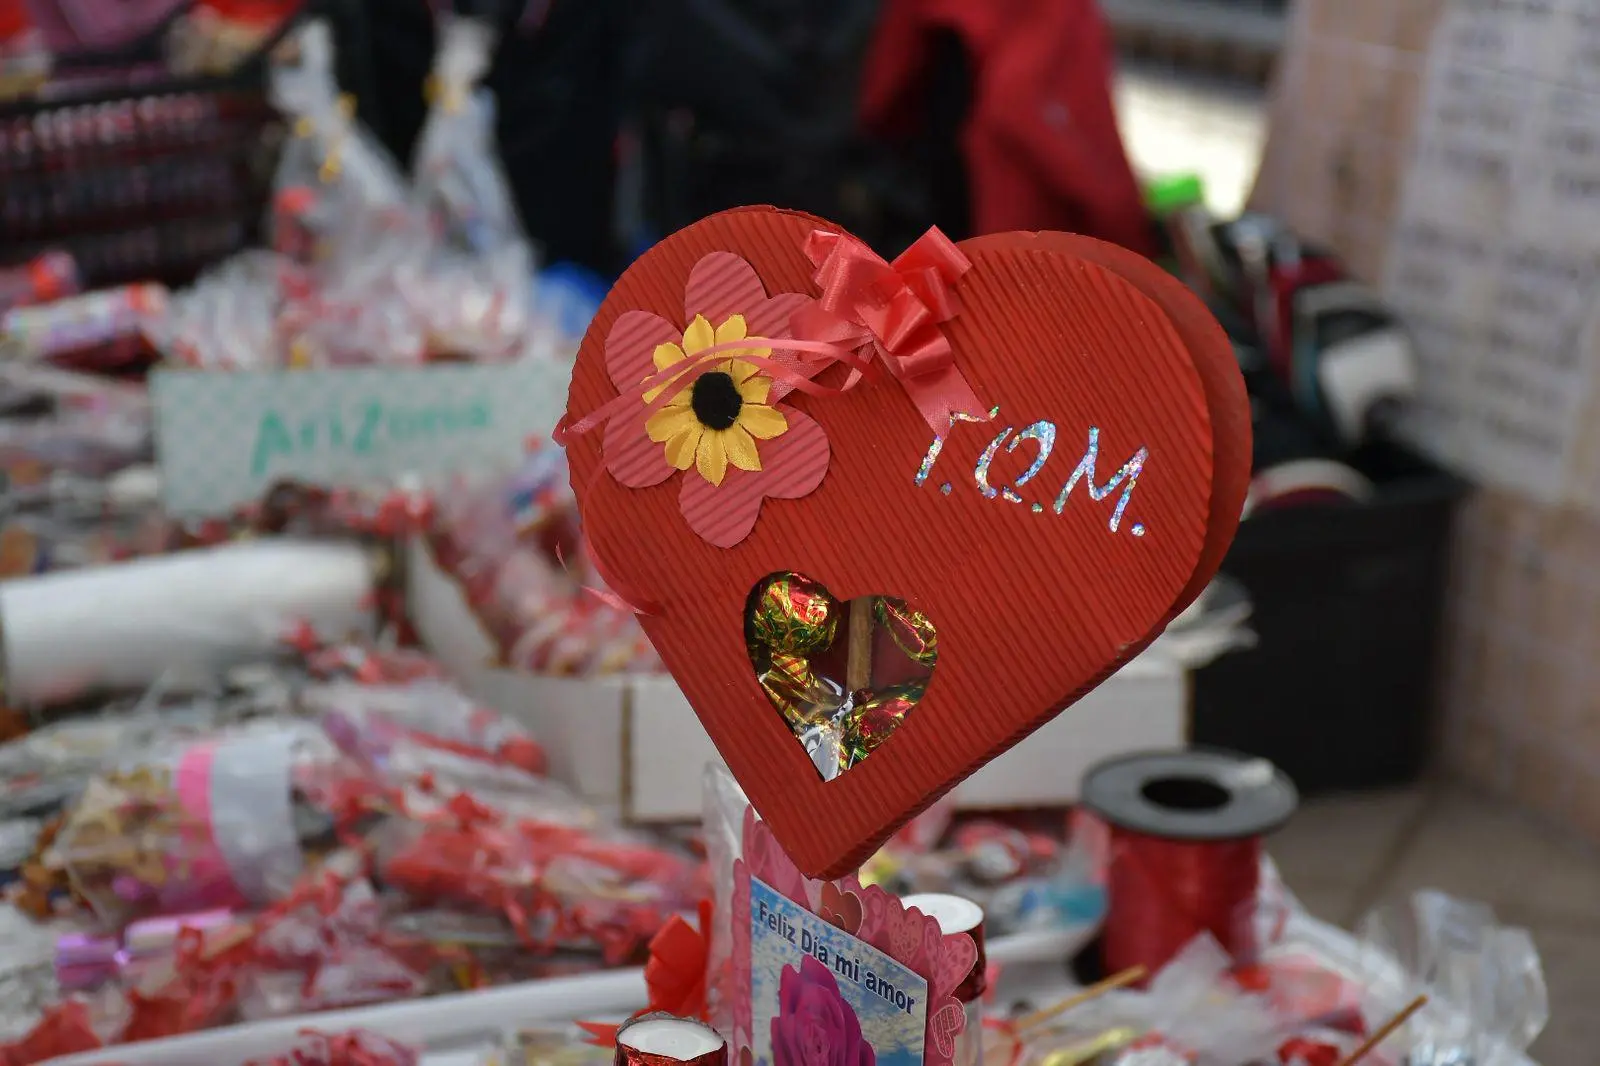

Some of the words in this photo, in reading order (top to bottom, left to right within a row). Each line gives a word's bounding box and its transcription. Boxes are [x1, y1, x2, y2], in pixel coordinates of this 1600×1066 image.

[758, 901, 798, 945] Feliz
[800, 929, 829, 966] Día
[834, 951, 861, 983] mi
[864, 968, 916, 1016] amor
